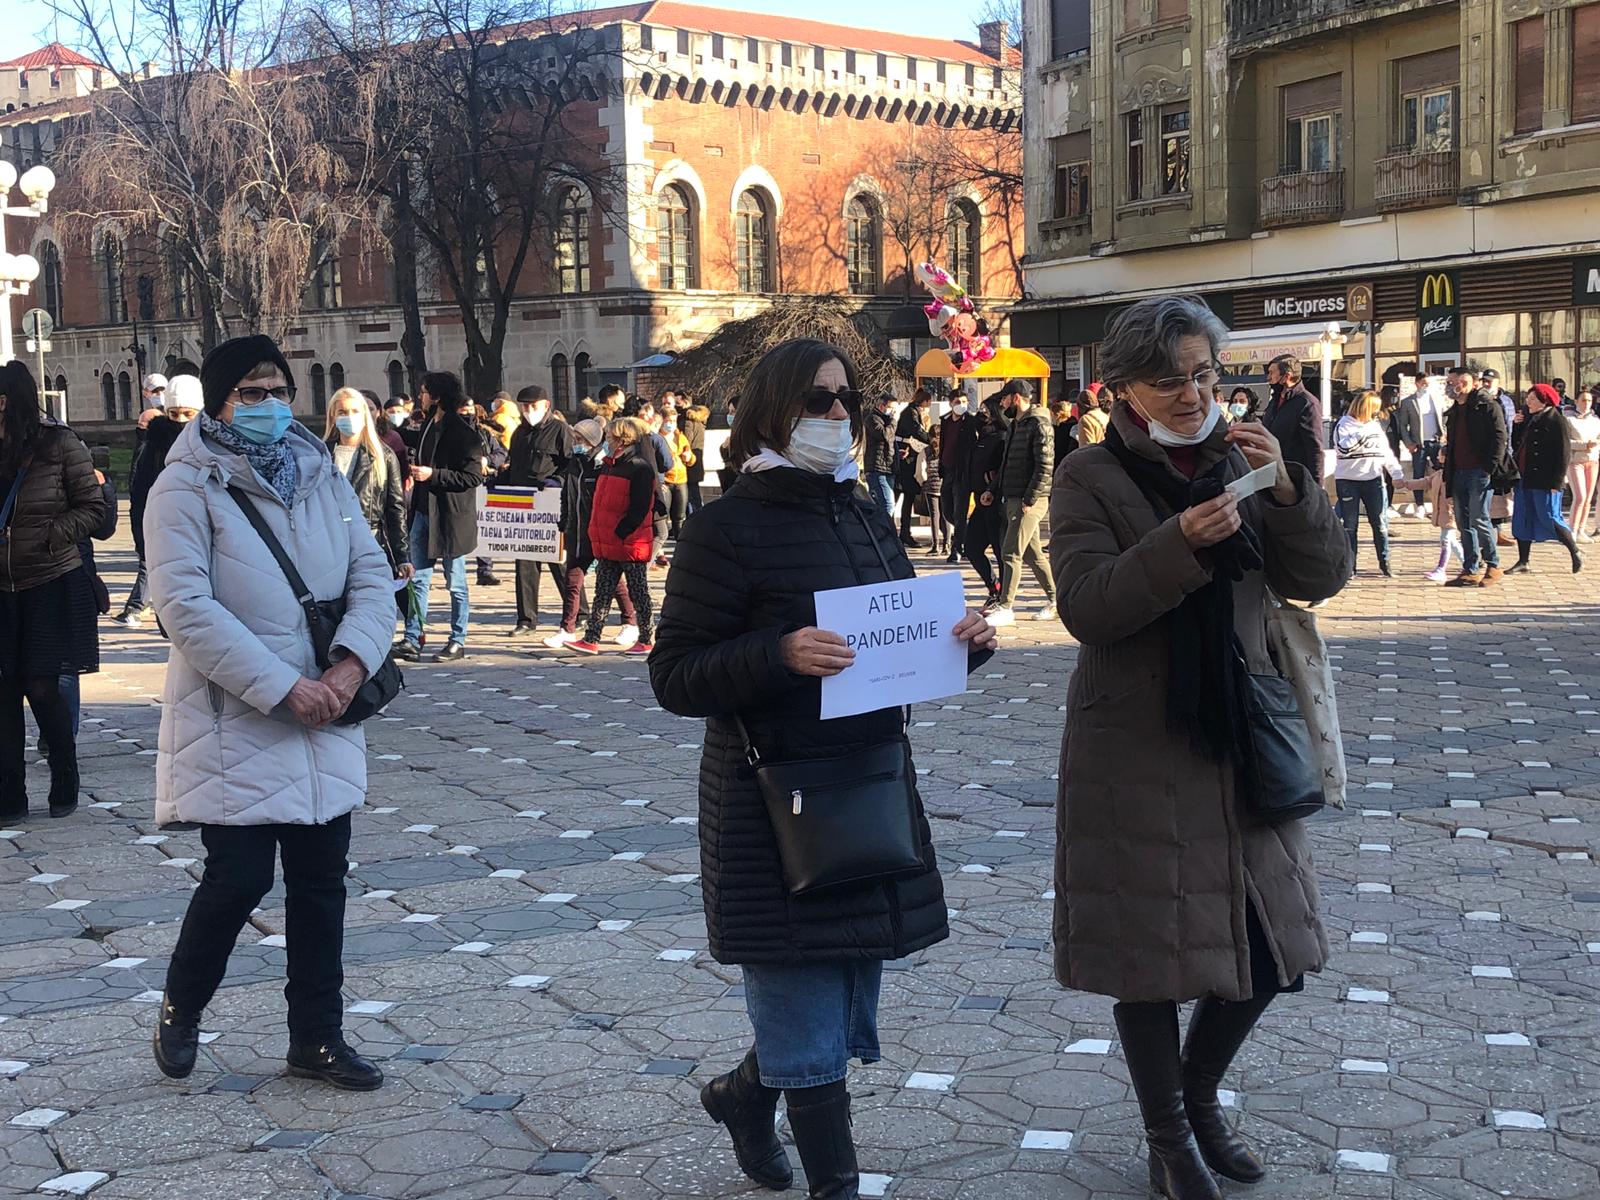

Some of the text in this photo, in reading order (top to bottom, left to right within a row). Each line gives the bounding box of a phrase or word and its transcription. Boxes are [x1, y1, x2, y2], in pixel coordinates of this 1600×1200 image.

[1264, 296, 1345, 317] McExpress
[1356, 295, 1367, 305] 24
[488, 543, 509, 552] TUDOR
[868, 590, 913, 614] ATEU
[846, 620, 938, 650] PANDEMIE
